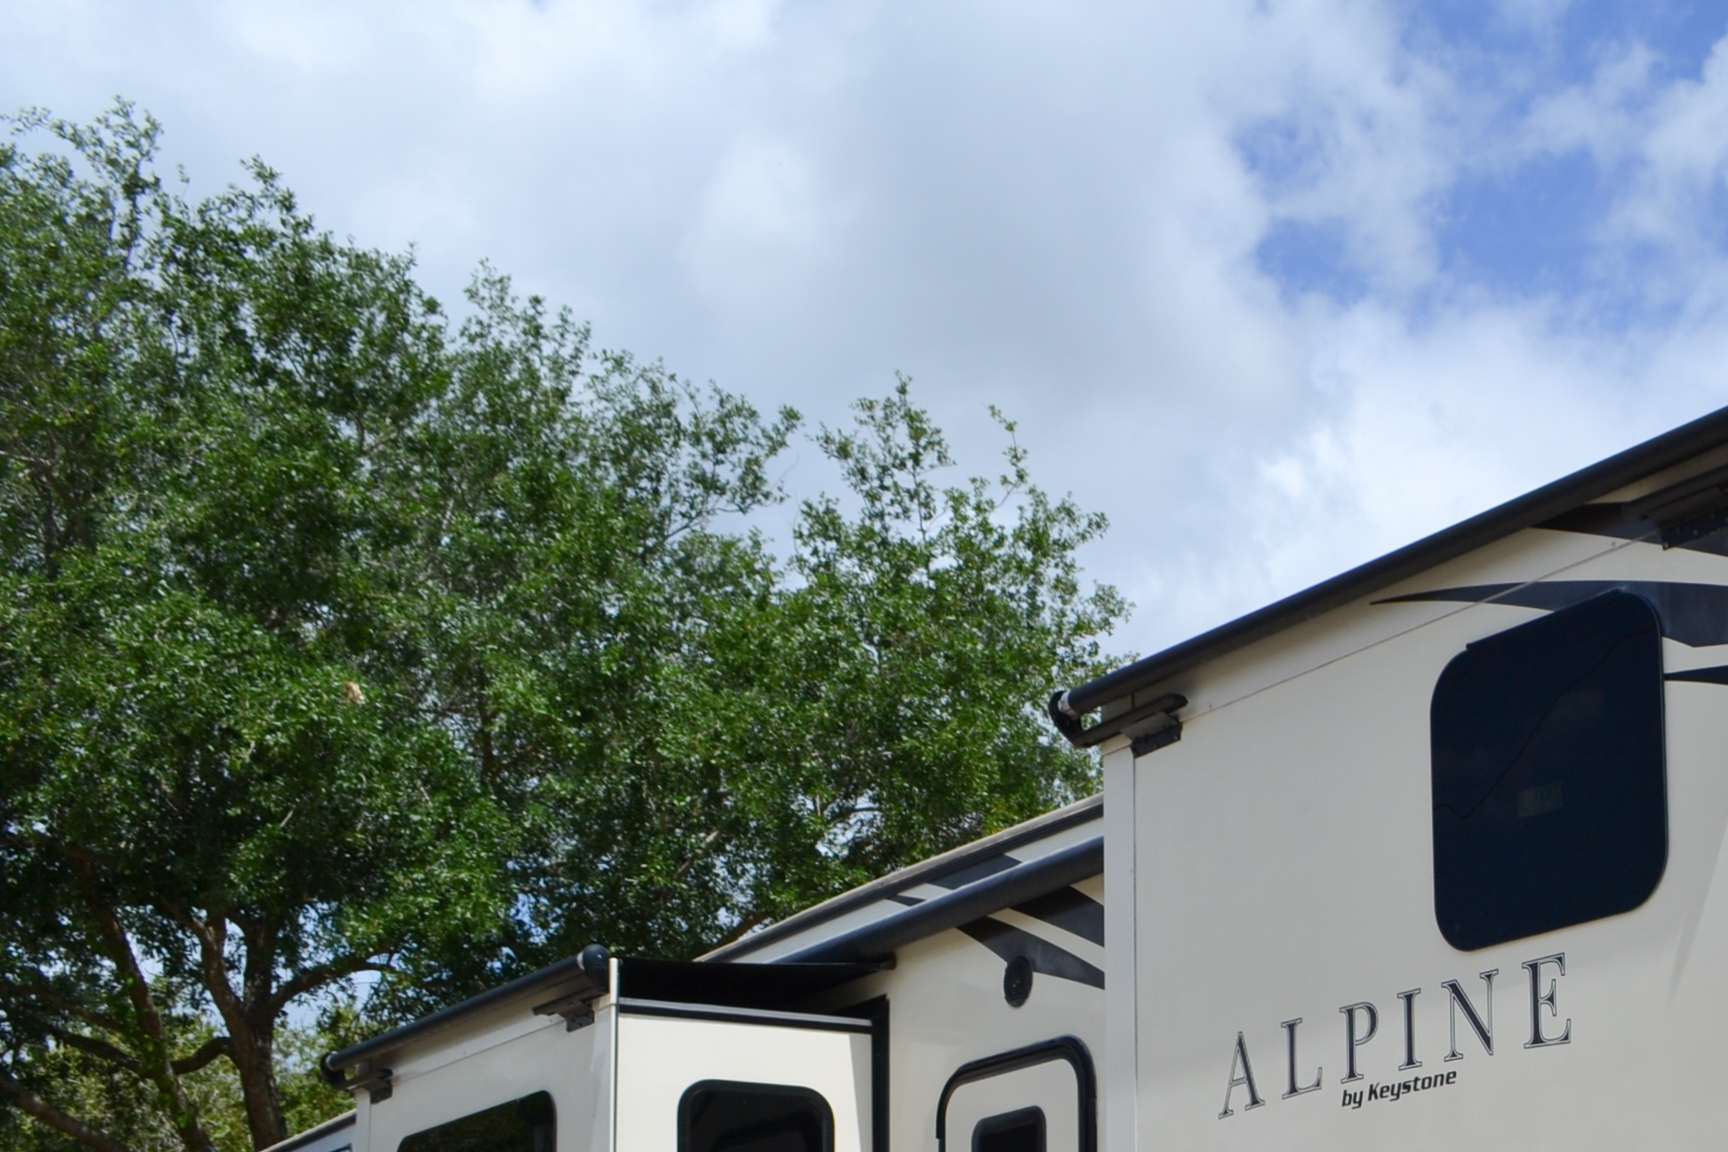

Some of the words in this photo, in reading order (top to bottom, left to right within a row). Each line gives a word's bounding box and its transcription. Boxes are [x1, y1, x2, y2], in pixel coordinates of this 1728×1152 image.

[1218, 952, 1572, 1119] ALPINE
[1341, 1088, 1363, 1109] by
[1367, 1070, 1457, 1102] Keystone
